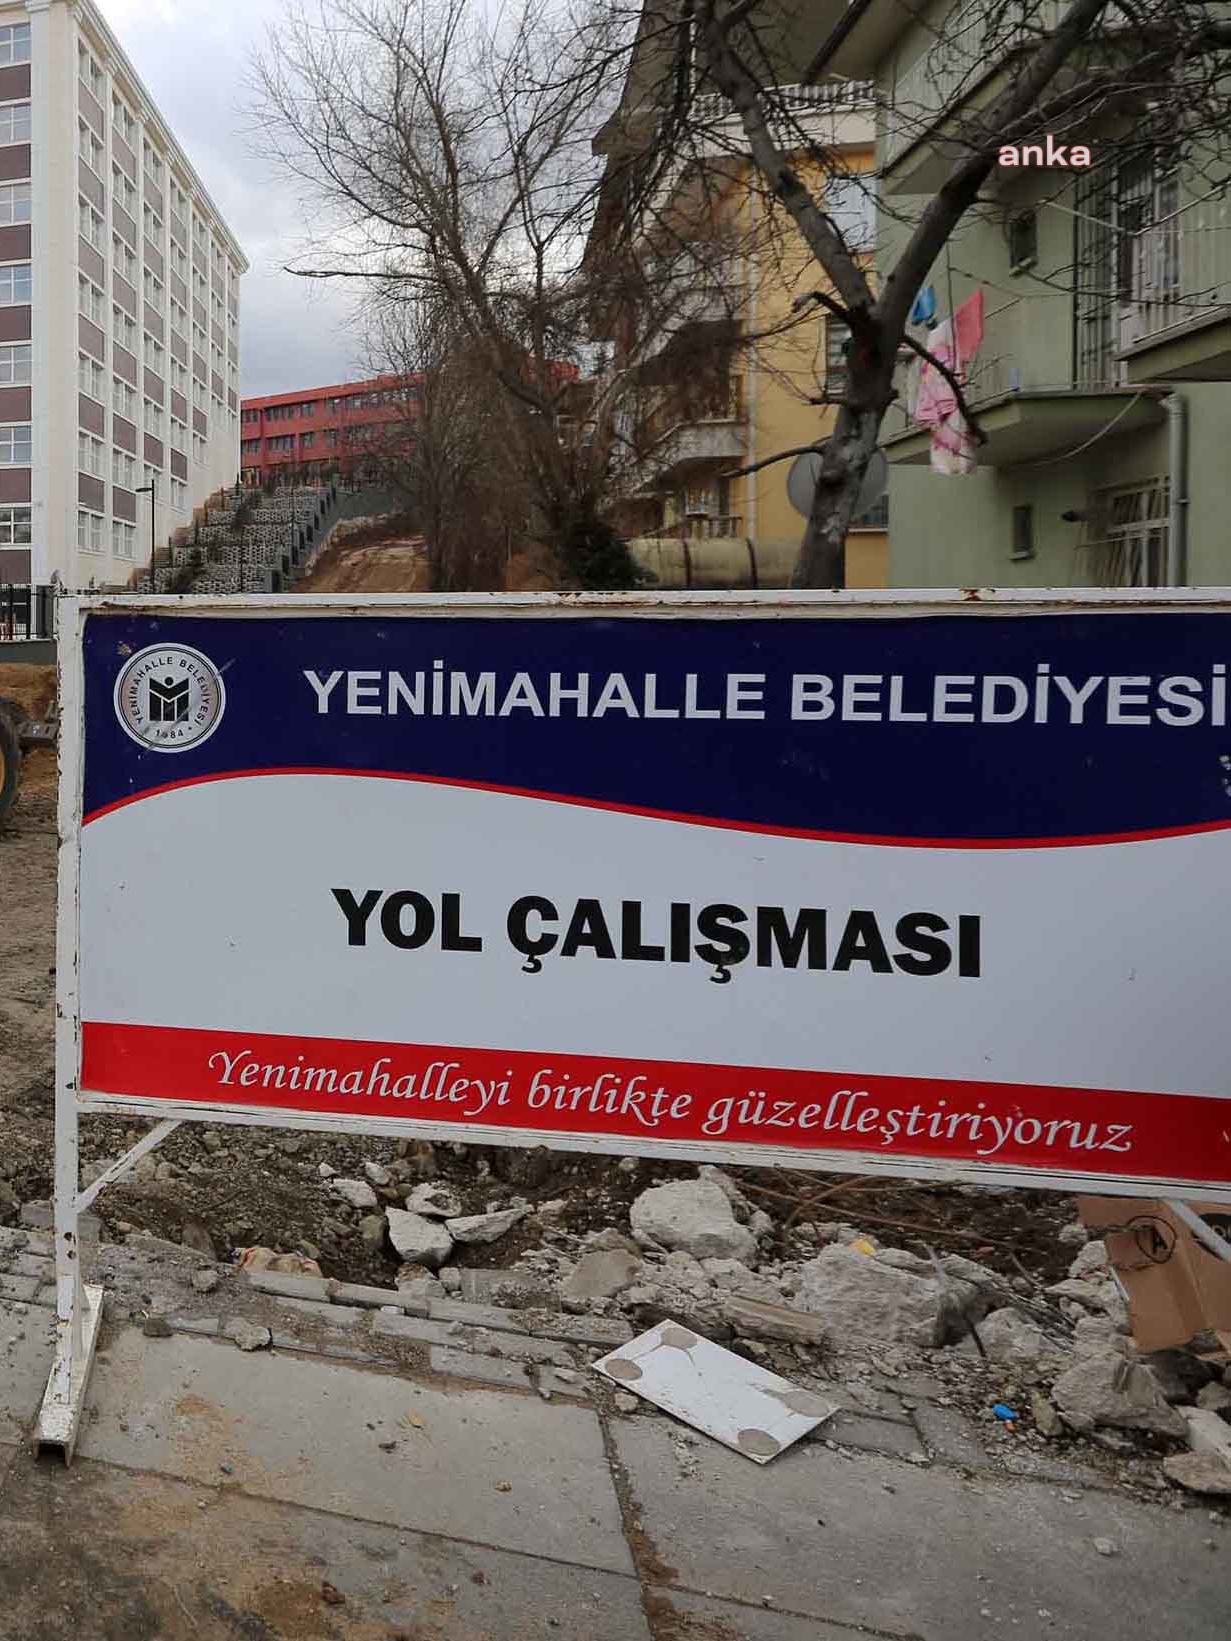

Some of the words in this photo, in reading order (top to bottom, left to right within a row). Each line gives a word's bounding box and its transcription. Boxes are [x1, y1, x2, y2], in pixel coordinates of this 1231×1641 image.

[303, 660, 766, 719] YENİMAHALLE
[790, 663, 1227, 727] BELEDİYESİ
[331, 888, 483, 952] YOL
[507, 895, 981, 984] ÇALIŞMASI
[208, 1050, 511, 1115] Yenimahalleyi
[527, 1069, 693, 1126] birlikte
[701, 1090, 1135, 1156] güzelleştiriyoruz
